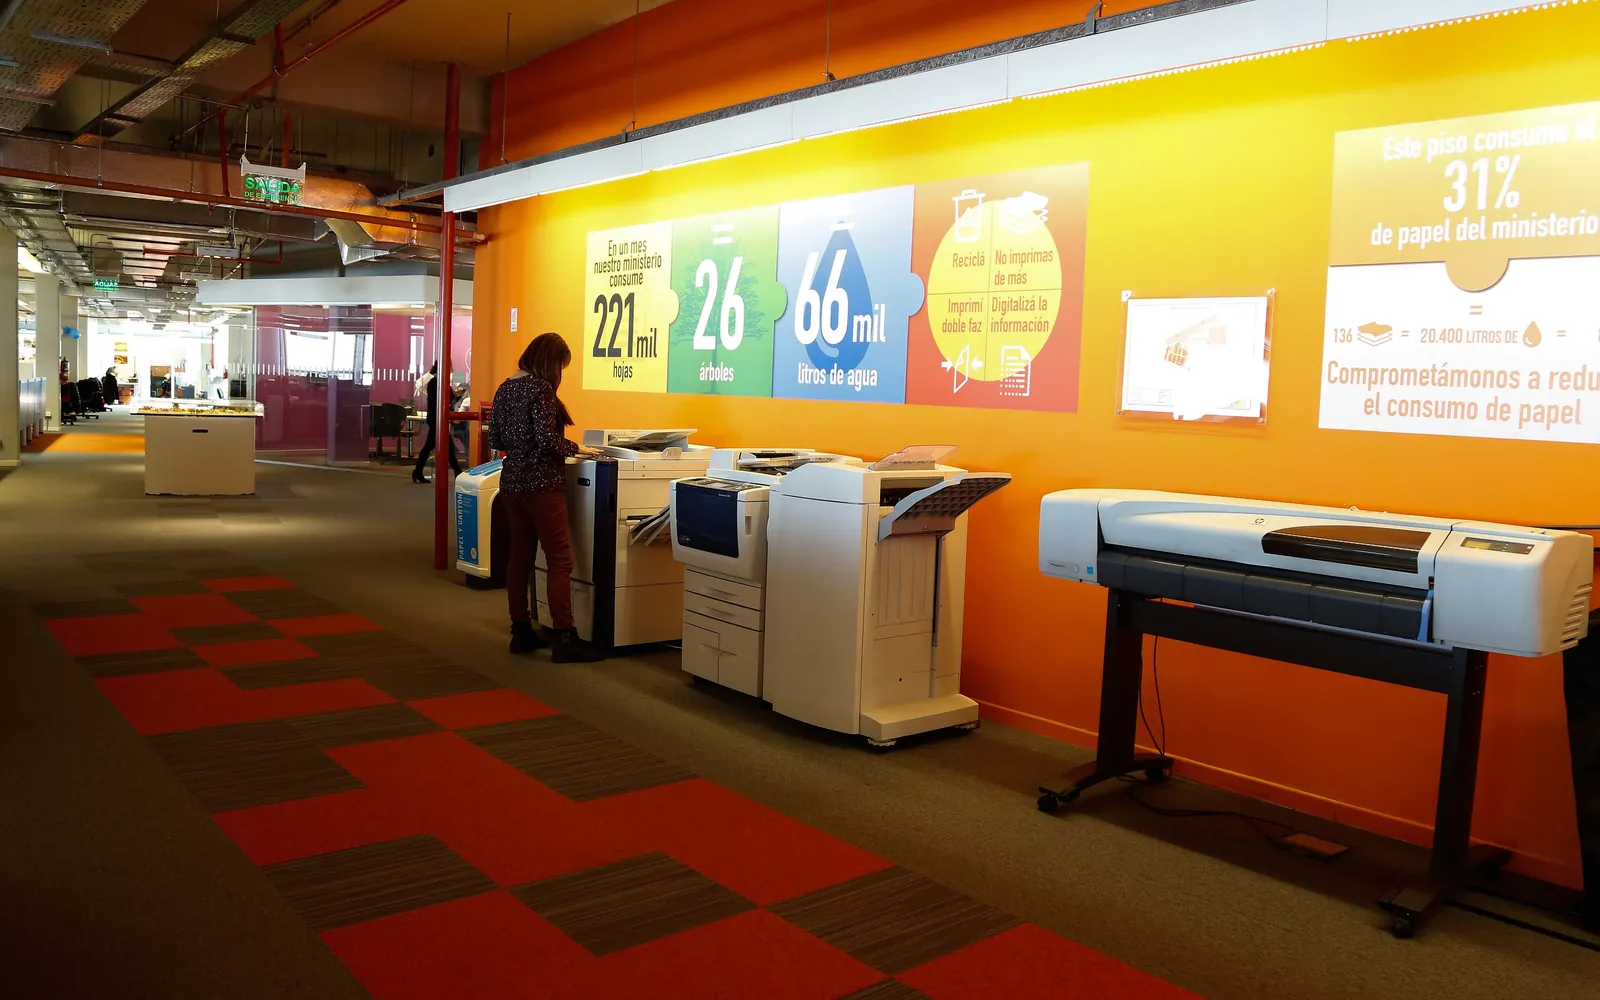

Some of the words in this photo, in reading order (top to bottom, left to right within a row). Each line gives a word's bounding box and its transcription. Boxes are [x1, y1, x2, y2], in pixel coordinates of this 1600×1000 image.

[1382, 136, 1422, 161] Este
[1427, 131, 1468, 163] piso
[1473, 123, 1568, 151] consume
[1574, 115, 1596, 141] el
[245, 177, 301, 194] SALIDA
[1443, 154, 1521, 212] 31%
[1371, 222, 1393, 246] de
[1398, 218, 1451, 251] papel
[1456, 215, 1486, 241] del
[1492, 209, 1599, 239] ministerio
[608, 239, 617, 257] En
[619, 243, 628, 256] un
[631, 240, 647, 254] mes
[995, 250, 1007, 265] No
[1009, 248, 1054, 267] imprimas
[594, 256, 621, 274] nuestro
[623, 252, 662, 271] ministerio
[952, 251, 985, 268] Reciclá
[609, 272, 643, 287] consume
[994, 270, 1005, 286] de
[1007, 269, 1027, 285] más
[693, 256, 744, 351] 26
[794, 249, 849, 345] 66
[852, 303, 886, 343] mil
[948, 297, 984, 317] Imprimí
[992, 295, 1035, 316] Digitalizá
[1038, 295, 1048, 311] la
[592, 292, 635, 358] 221
[636, 328, 657, 358] mil
[942, 318, 966, 333] doble
[968, 318, 982, 333] faz
[990, 316, 1049, 333] información
[1333, 328, 1353, 344] 136
[1420, 328, 1463, 344] 20.400
[1466, 330, 1502, 344] LITROS
[1505, 330, 1518, 344] DE
[613, 360, 633, 382] hojas
[699, 362, 734, 382] árboles
[798, 363, 826, 385] litros
[829, 363, 844, 385] de
[847, 369, 878, 391] agua
[1327, 360, 1520, 391] Comprometámonos
[1528, 370, 1541, 390] a
[1549, 364, 1600, 391] redu
[1364, 392, 1380, 416] el
[1387, 397, 1478, 421] consumo
[1486, 396, 1511, 422] de
[1518, 399, 1581, 430] papel
